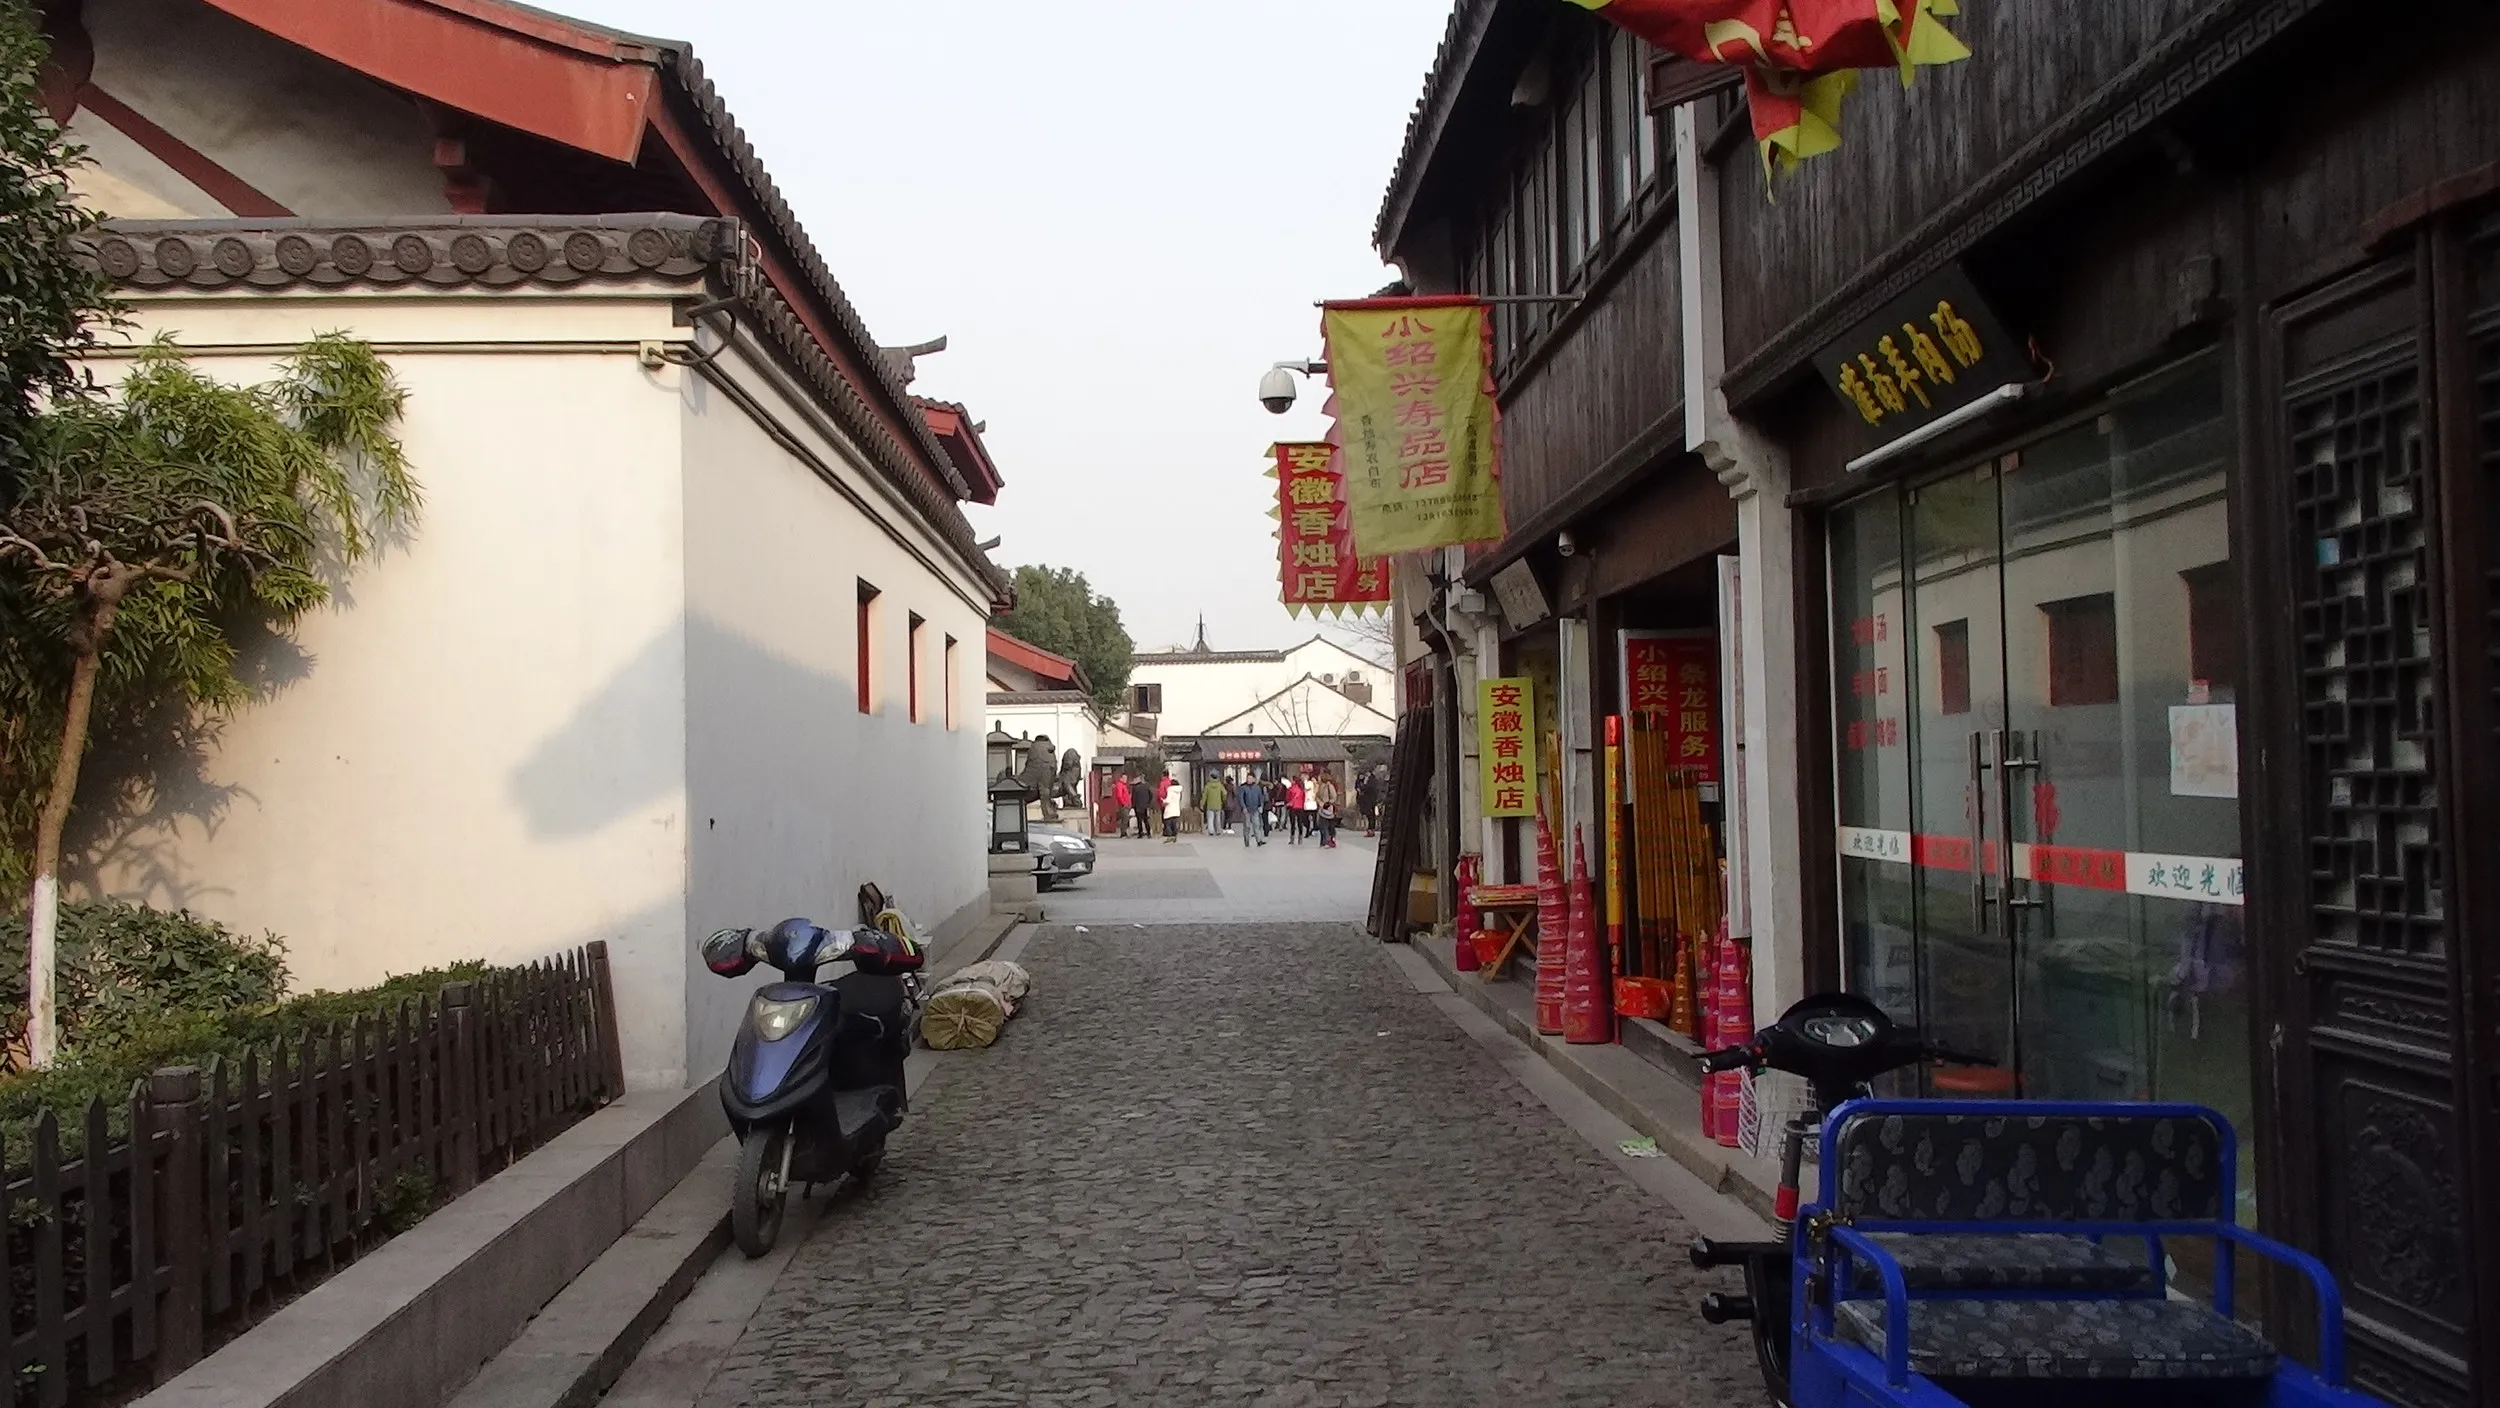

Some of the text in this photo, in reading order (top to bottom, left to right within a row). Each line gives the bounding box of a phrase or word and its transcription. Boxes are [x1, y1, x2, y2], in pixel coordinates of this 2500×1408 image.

[1382, 315, 1450, 489] 小绍兴寿品店
[1288, 446, 1339, 600] 安徽香烛店
[1490, 683, 1525, 811] 安徽香烛店
[1677, 646, 1710, 758] 一条龙服务
[1852, 835, 1900, 857] 欢迎光临
